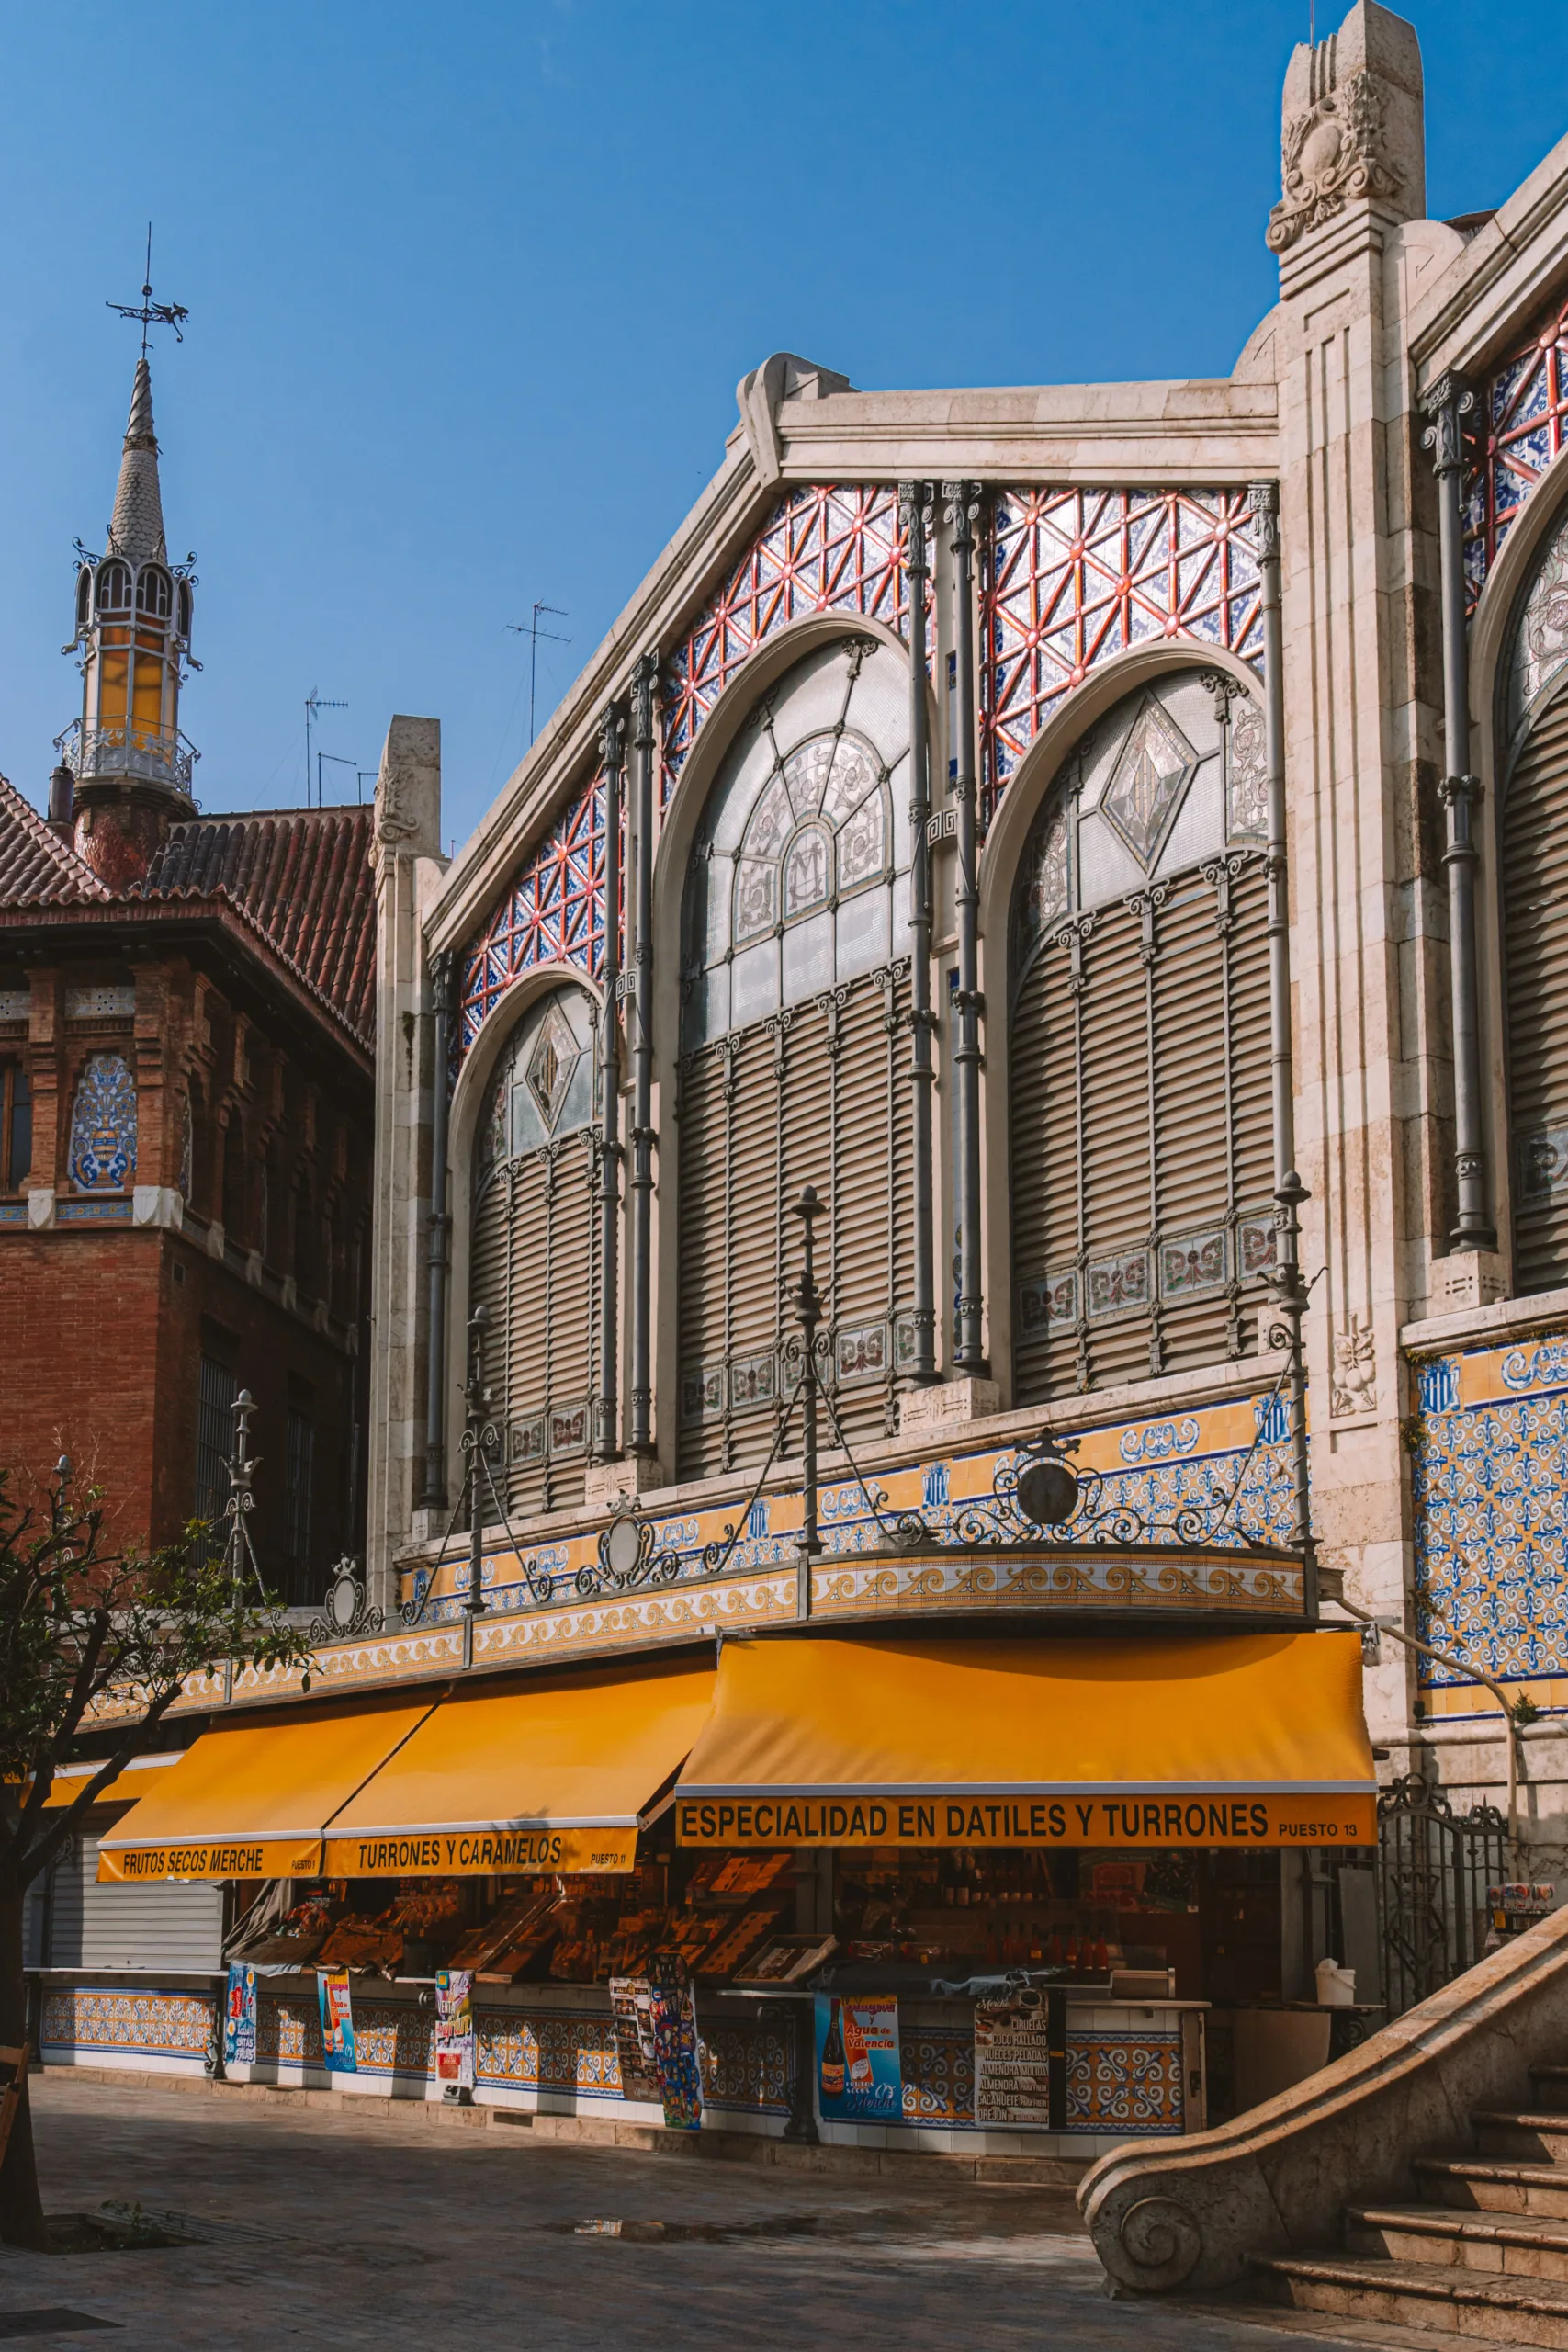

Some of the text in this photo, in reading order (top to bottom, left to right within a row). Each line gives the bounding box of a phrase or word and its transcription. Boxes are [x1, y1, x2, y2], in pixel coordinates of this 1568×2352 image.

[682, 1804, 1268, 1838] ESPECIALIDAD EN DATILES Y TURRONES
[1279, 1824, 1358, 1837] PUESTO 13
[359, 1837, 561, 1868] TURRONES Y CARAMELOS
[591, 1853, 618, 1865] PUESTO
[123, 1849, 264, 1874] FRUTOS SECOS MERCHE
[291, 1860, 311, 1870] PUESTO
[437, 2000, 456, 2014] VENTA
[846, 2024, 878, 2037] Agua
[1011, 2019, 1046, 2030] CIRUELAS
[848, 2039, 895, 2048] Valencia
[992, 2034, 1046, 2046] COCO RALLADO
[985, 2049, 1046, 2062] NUECES PELADAS
[980, 2064, 1047, 2076] ALMENDRA MOLIDA
[979, 2078, 1019, 2091] ALMENDRA
[977, 2094, 1019, 2106] CACAHUETE
